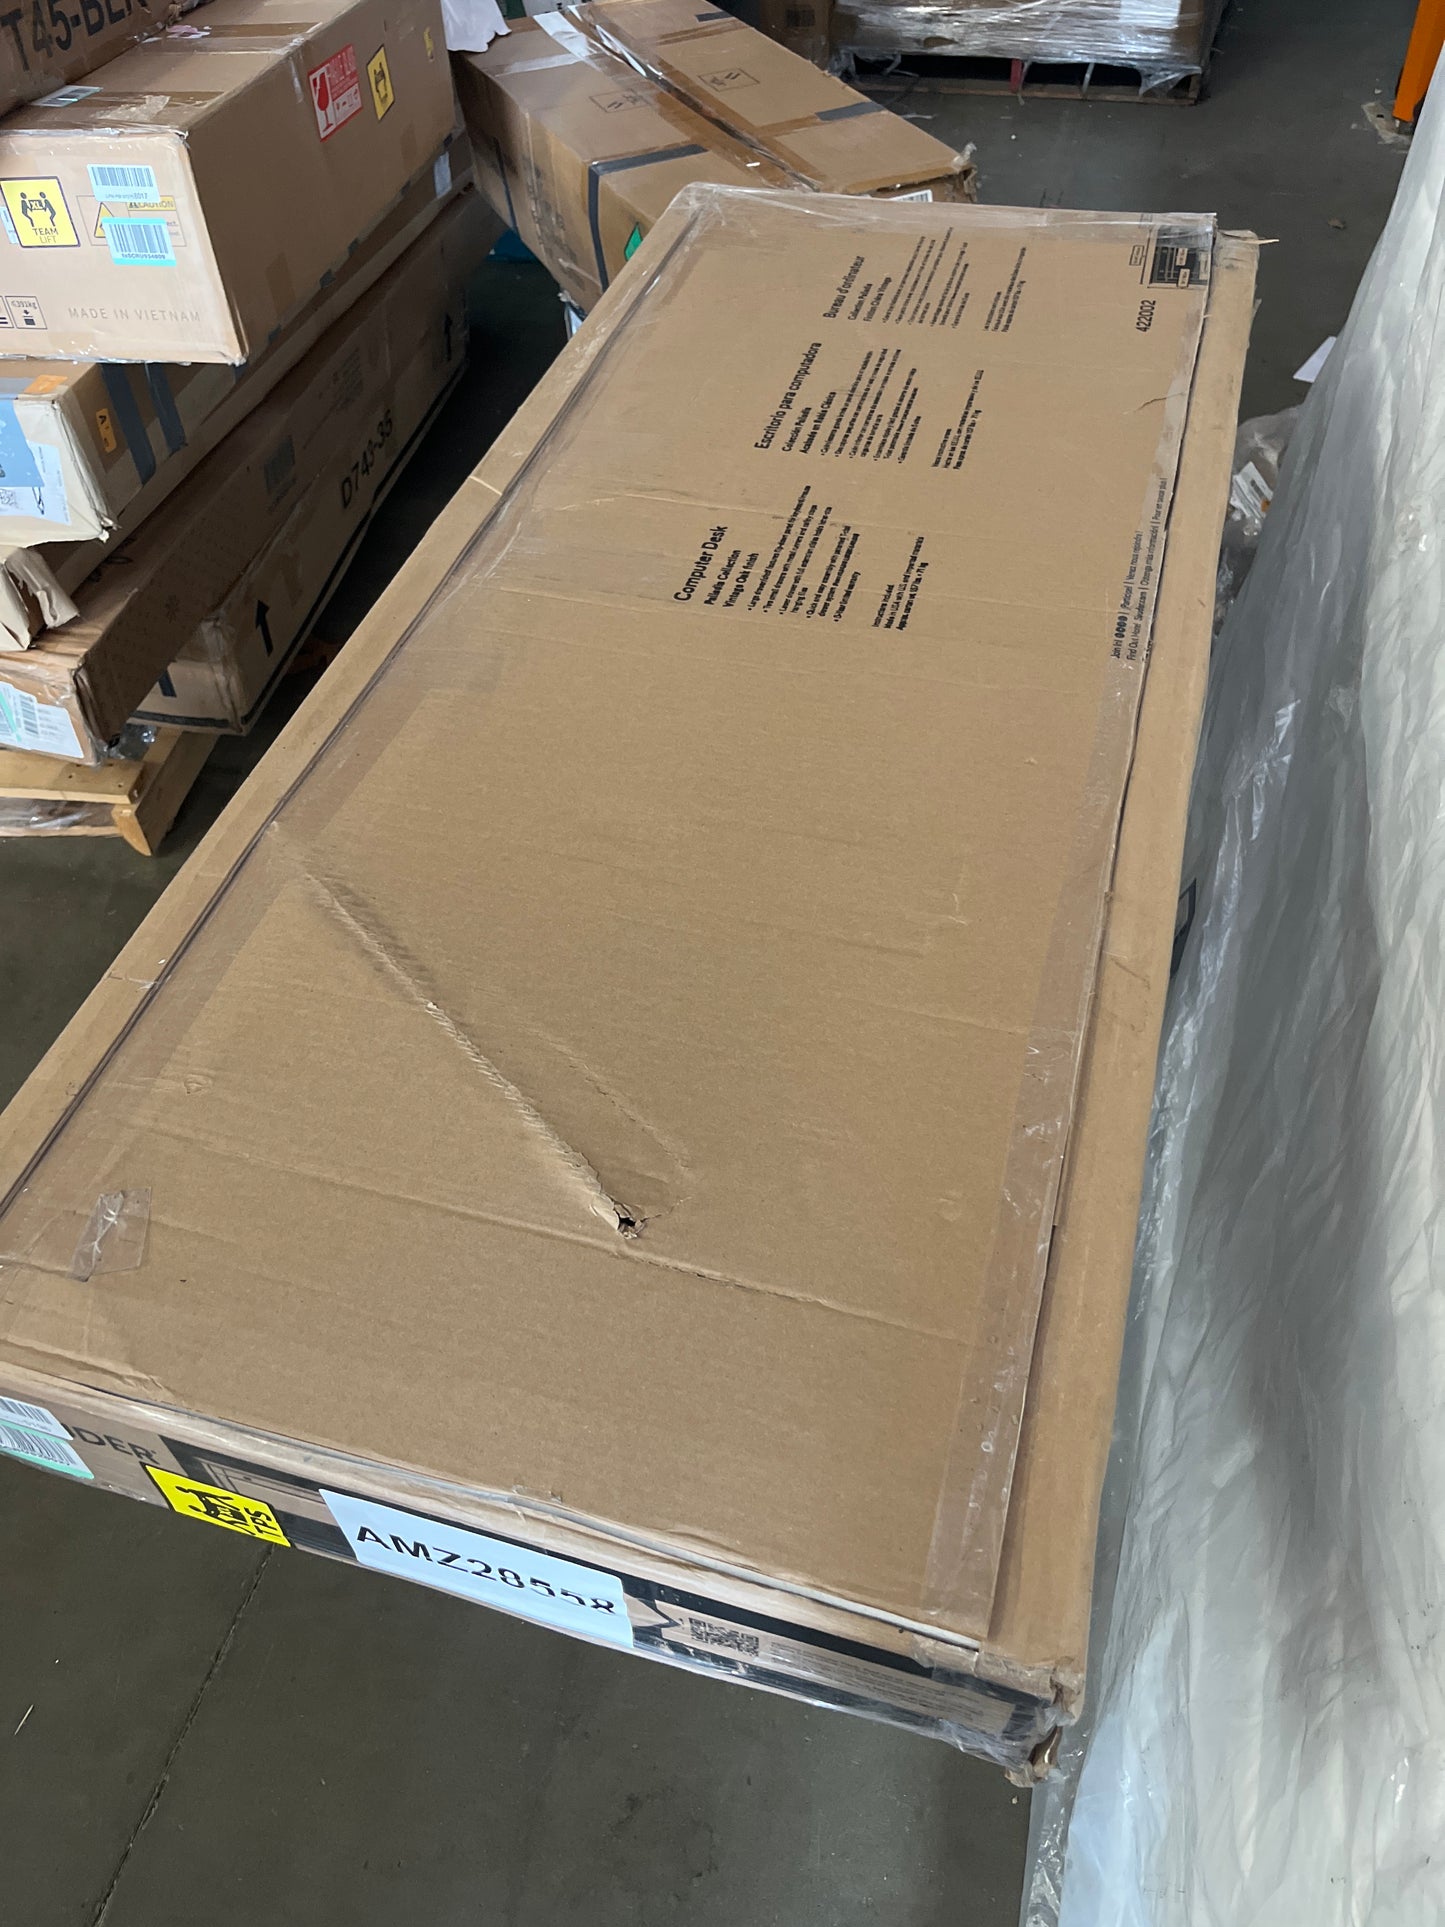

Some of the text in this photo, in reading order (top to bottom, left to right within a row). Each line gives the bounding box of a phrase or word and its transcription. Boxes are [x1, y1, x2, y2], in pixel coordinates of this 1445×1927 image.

[32, 228, 59, 236] TEAM
[40, 235, 57, 244] LIFT
[822, 255, 864, 318] Bureau d'ordinateur
[68, 307, 201, 323] MADE IN VIETNAM
[1135, 299, 1156, 332] 422002
[754, 342, 822, 449] Escritorio para computadora
[673, 525, 728, 601] Computer Desk
[703, 549, 741, 605] Palladia Collection
[722, 552, 759, 607] Vintage Oak finish
[1110, 646, 1121, 659] Join
[1125, 647, 1137, 661] Find
[60, 1422, 160, 1466] DER
